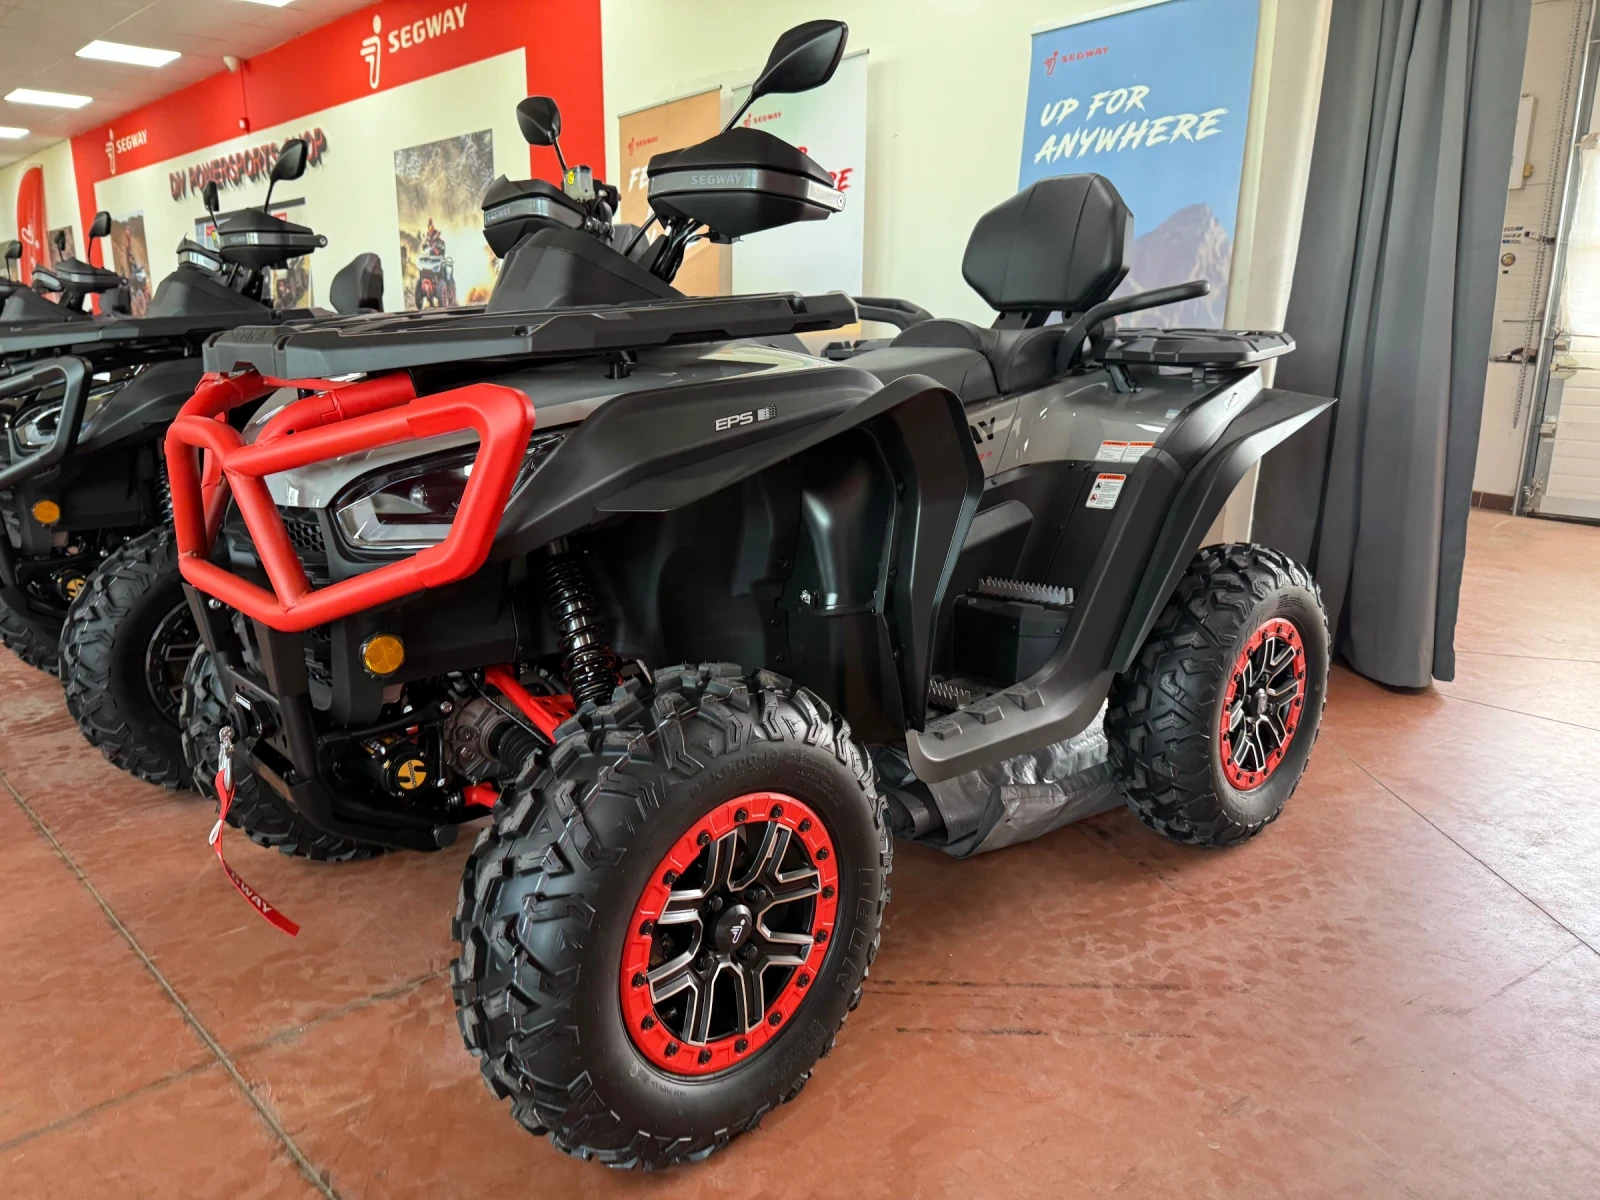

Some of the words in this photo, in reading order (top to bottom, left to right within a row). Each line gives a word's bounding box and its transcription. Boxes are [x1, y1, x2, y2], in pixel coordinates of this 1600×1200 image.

[388, 3, 467, 53] SEGWAY
[1061, 46, 1109, 63] SEGWAY
[753, 111, 782, 124] SEGWAY
[1040, 98, 1080, 127] UP
[1086, 85, 1150, 121] FOR
[116, 128, 147, 154] SEGWAY
[1034, 108, 1229, 165] ANYWHERE
[691, 173, 743, 185] SEGWAY
[715, 411, 754, 432] EPS
